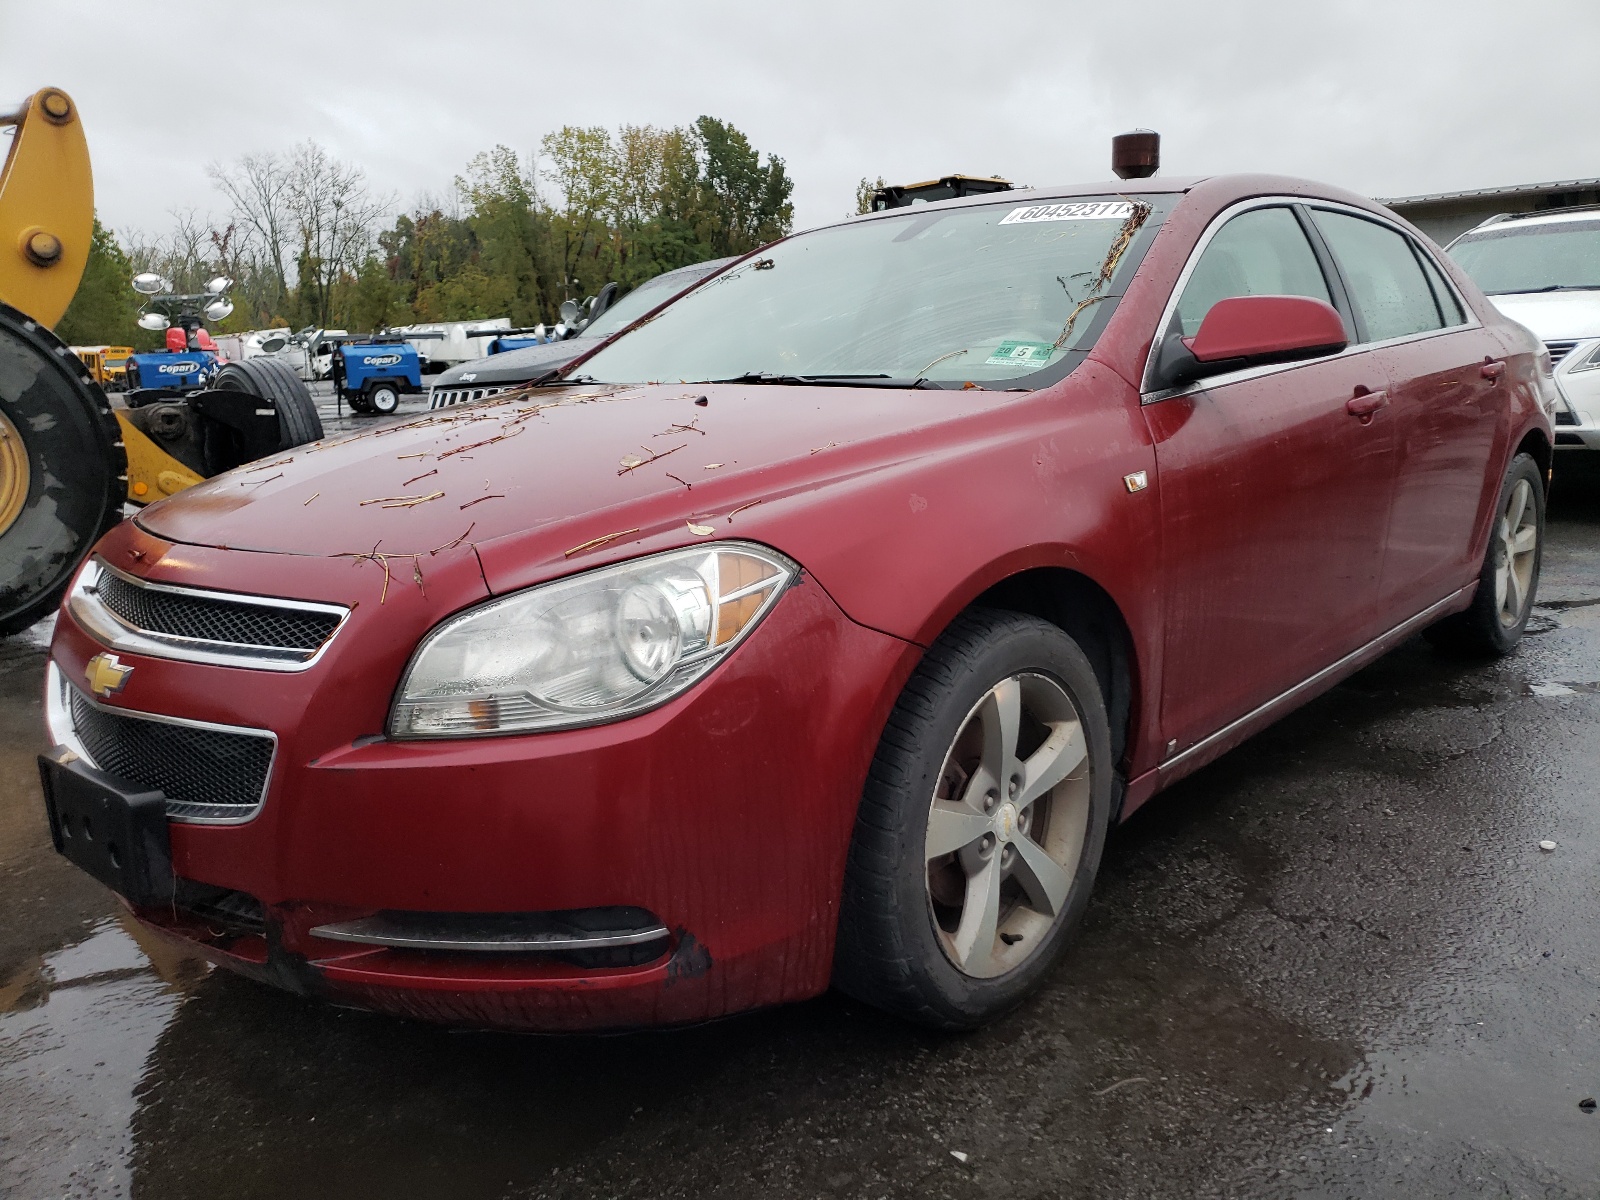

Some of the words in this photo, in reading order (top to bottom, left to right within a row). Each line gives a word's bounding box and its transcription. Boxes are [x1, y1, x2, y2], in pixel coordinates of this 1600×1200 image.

[1020, 202, 1127, 220] 60452311
[363, 356, 399, 366] Copart
[159, 363, 197, 374] Copart
